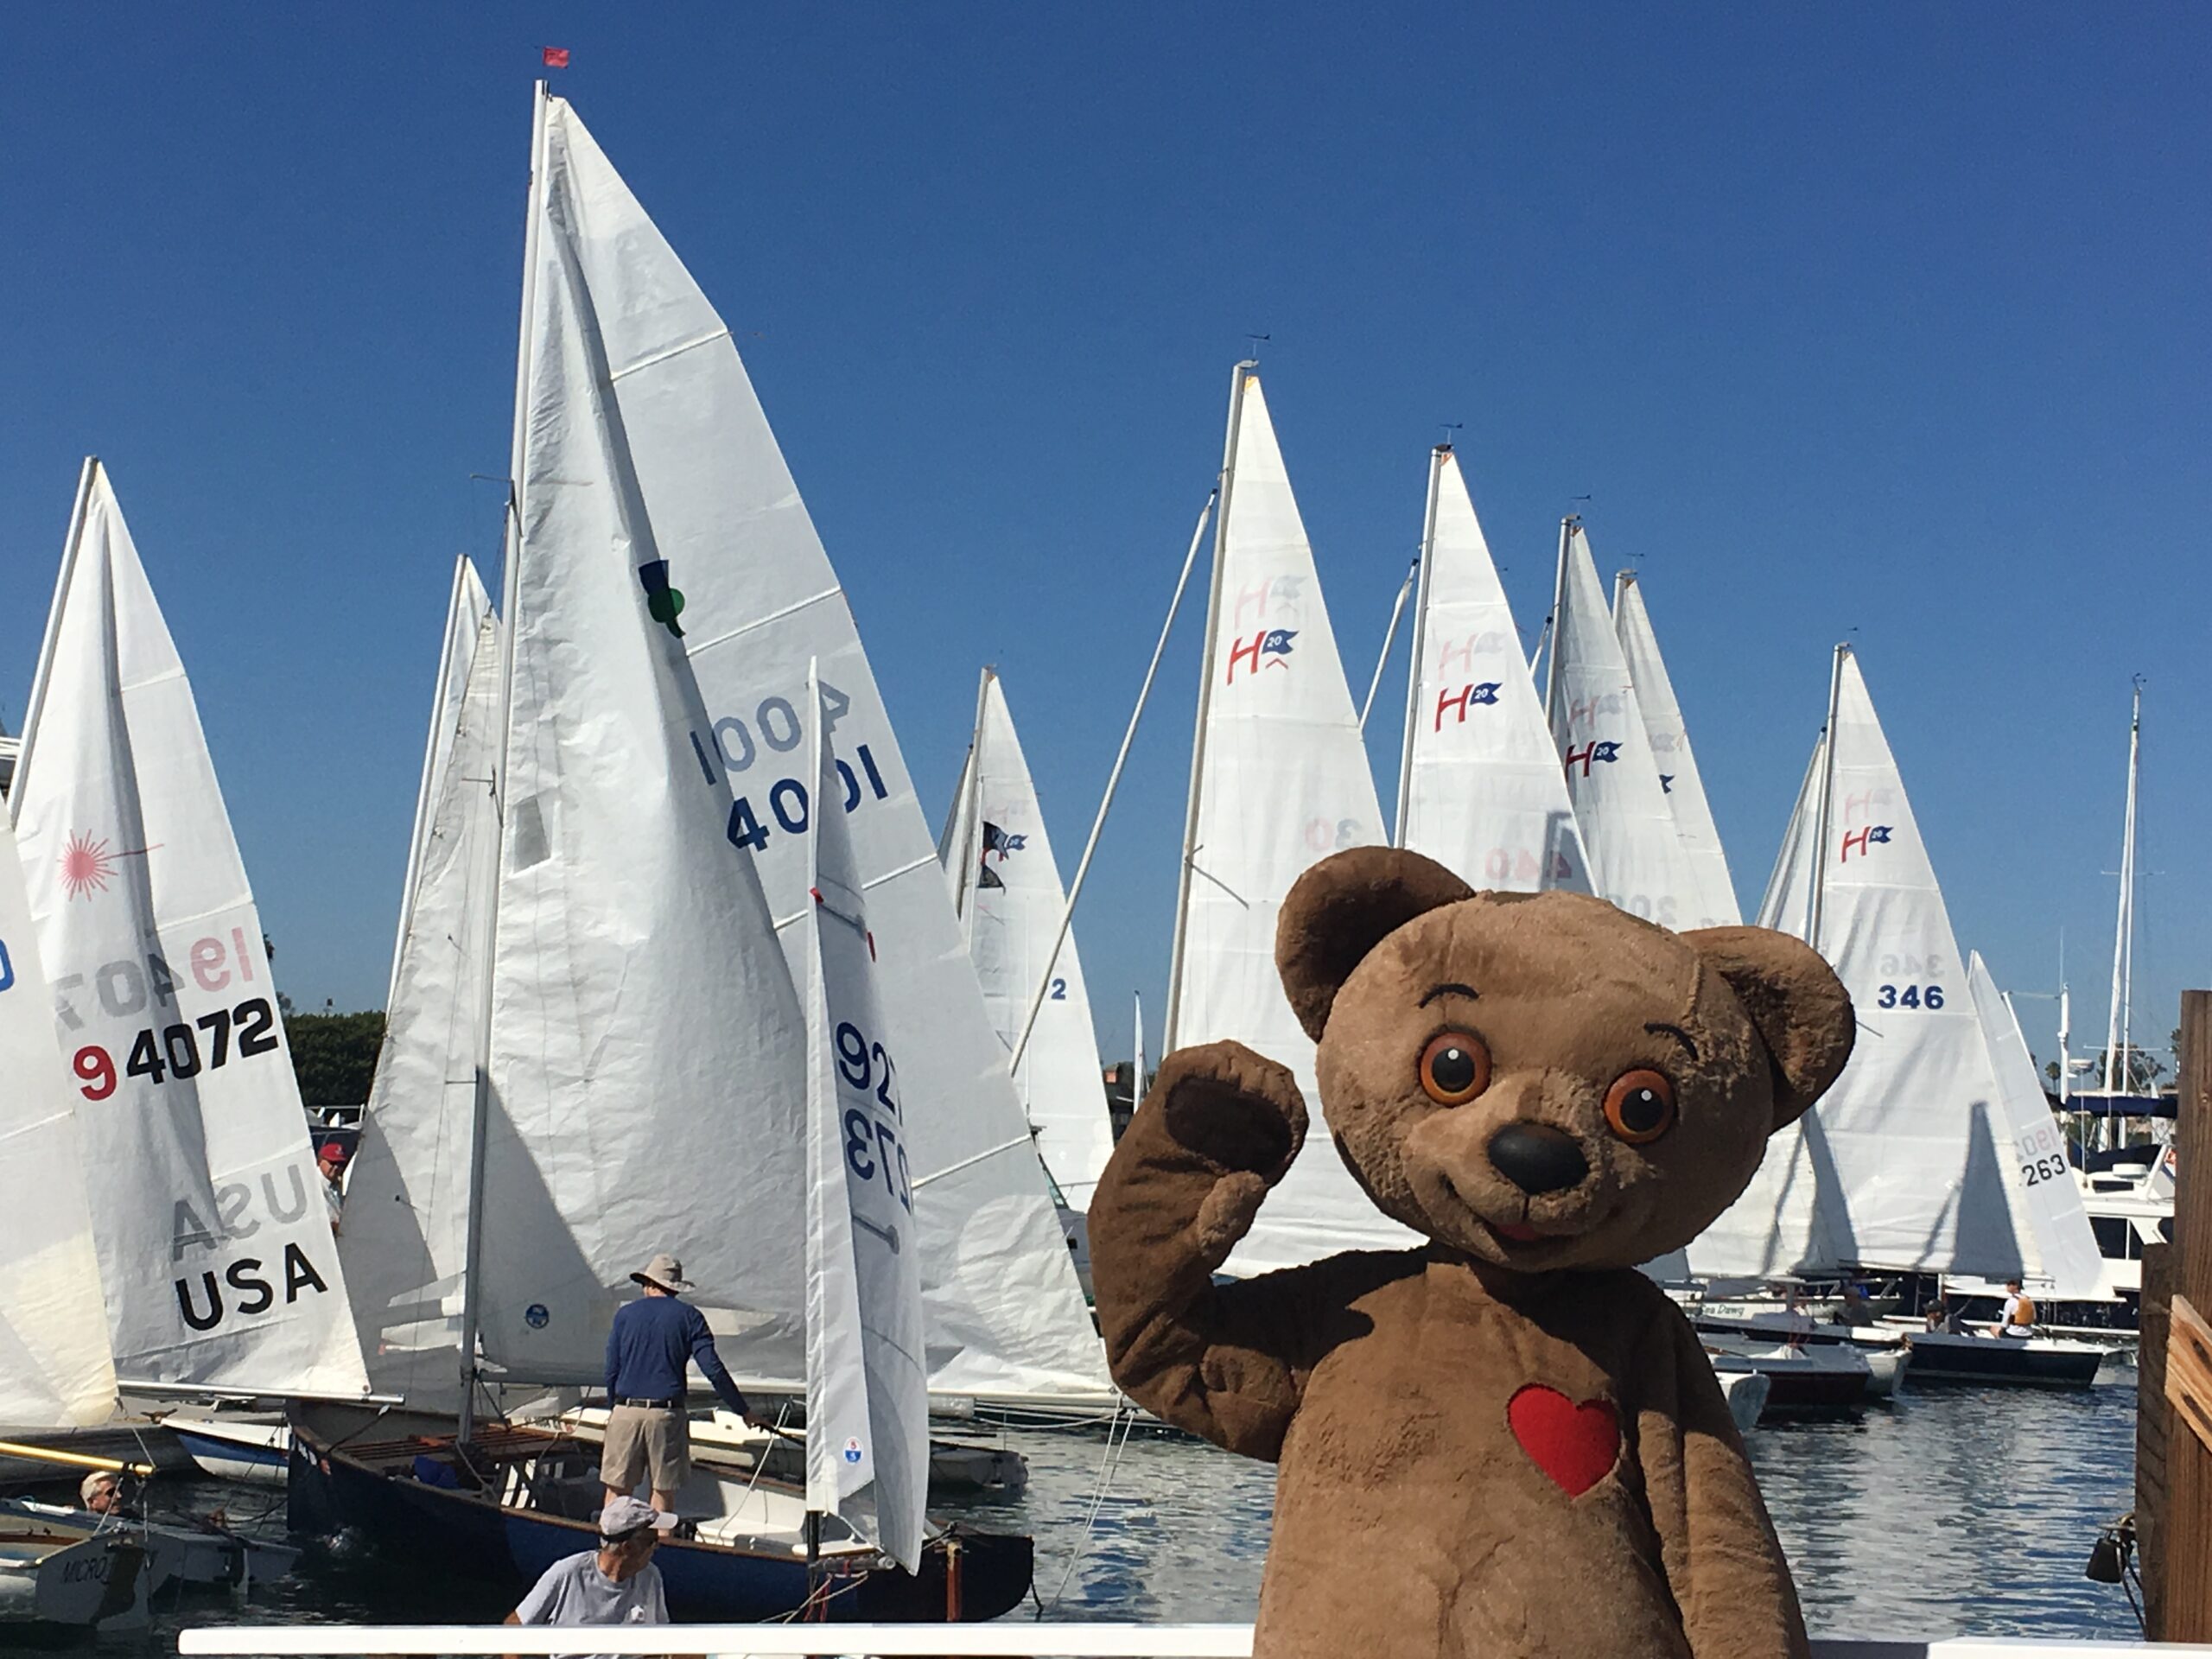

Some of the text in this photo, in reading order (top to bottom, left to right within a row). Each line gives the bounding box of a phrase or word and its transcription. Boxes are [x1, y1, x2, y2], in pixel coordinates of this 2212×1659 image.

[1878, 984, 1944, 1010] 346
[73, 997, 279, 1102] 94072
[2021, 1154, 2066, 1187] 263
[175, 1242, 328, 1332] USA
